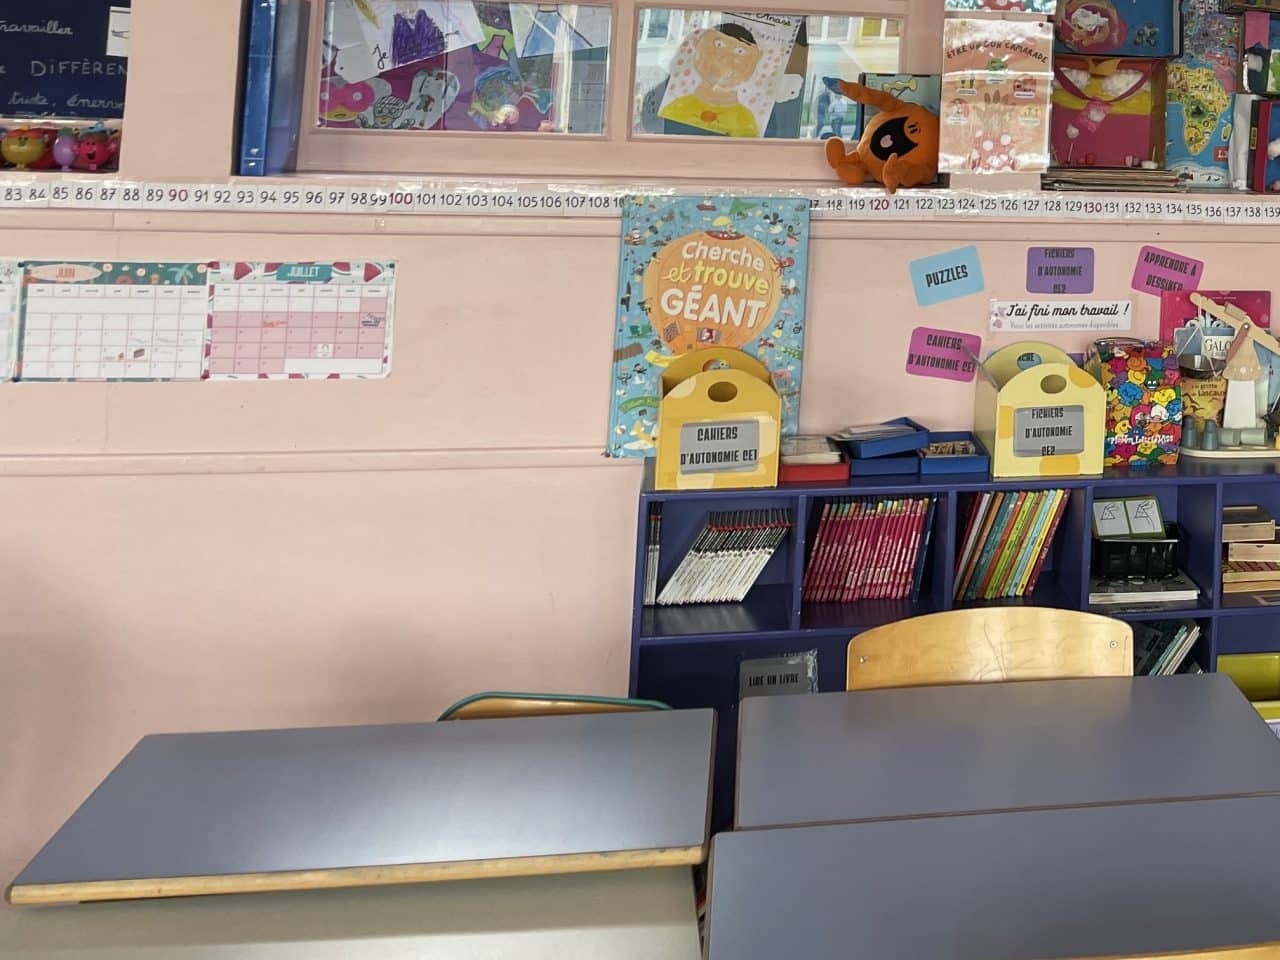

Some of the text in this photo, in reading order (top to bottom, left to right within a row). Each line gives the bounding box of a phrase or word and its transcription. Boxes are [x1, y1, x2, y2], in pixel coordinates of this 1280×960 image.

[373, 44, 388, 70] Je
[1005, 42, 1049, 64] CAMARADE
[5, 187, 609, 208] 83 84 85 86 87 88 89 90 91 92 93 94 95 96 97 98 99 100 101 102 103 104 105 106 107 108
[681, 240, 765, 271] Cherche
[1144, 251, 1190, 275] APPRENDRE
[287, 265, 320, 278] JUILLET
[665, 261, 771, 295] et trouve
[925, 264, 968, 288] PUZZLES
[1037, 266, 1082, 277] D'AUTONOMIE
[661, 285, 769, 328] GÉANT
[1006, 303, 1130, 320] J'ai fini mon travail !
[926, 334, 963, 350] CAHIERS
[908, 353, 960, 371] D'AUTONOMIE
[1032, 407, 1064, 419] FICHIERS
[697, 426, 739, 442] CAHIERS
[1025, 425, 1073, 439] D'AUTONOMIE
[680, 451, 740, 465] D'AUTONOMIE
[1041, 445, 1056, 456] CE2
